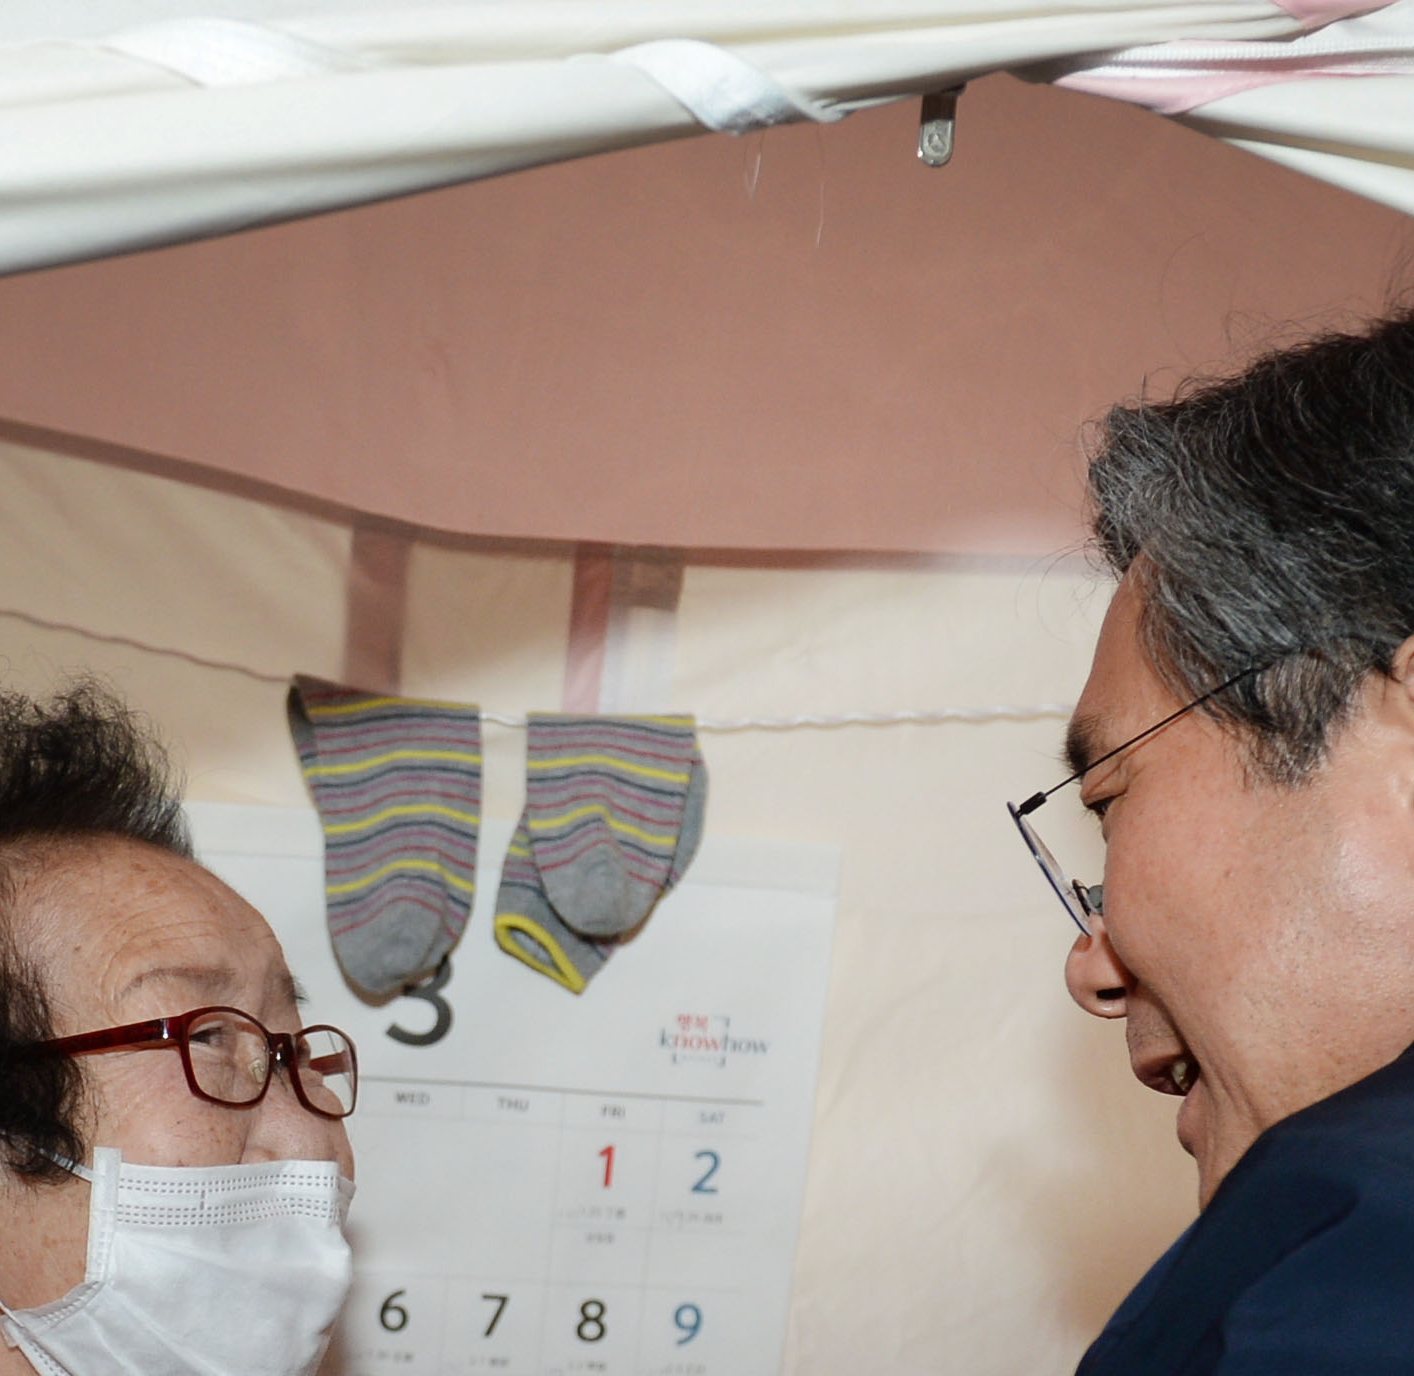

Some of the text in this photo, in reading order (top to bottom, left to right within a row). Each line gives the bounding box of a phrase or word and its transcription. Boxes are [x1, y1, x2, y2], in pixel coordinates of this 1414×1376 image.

[386, 956, 453, 1047] 3
[659, 1029, 768, 1055] knowhow
[395, 1091, 725, 1125] WED THU FRI SAT
[598, 1145, 720, 1195] 1 2
[379, 1289, 703, 1346] 6 7 8 9
